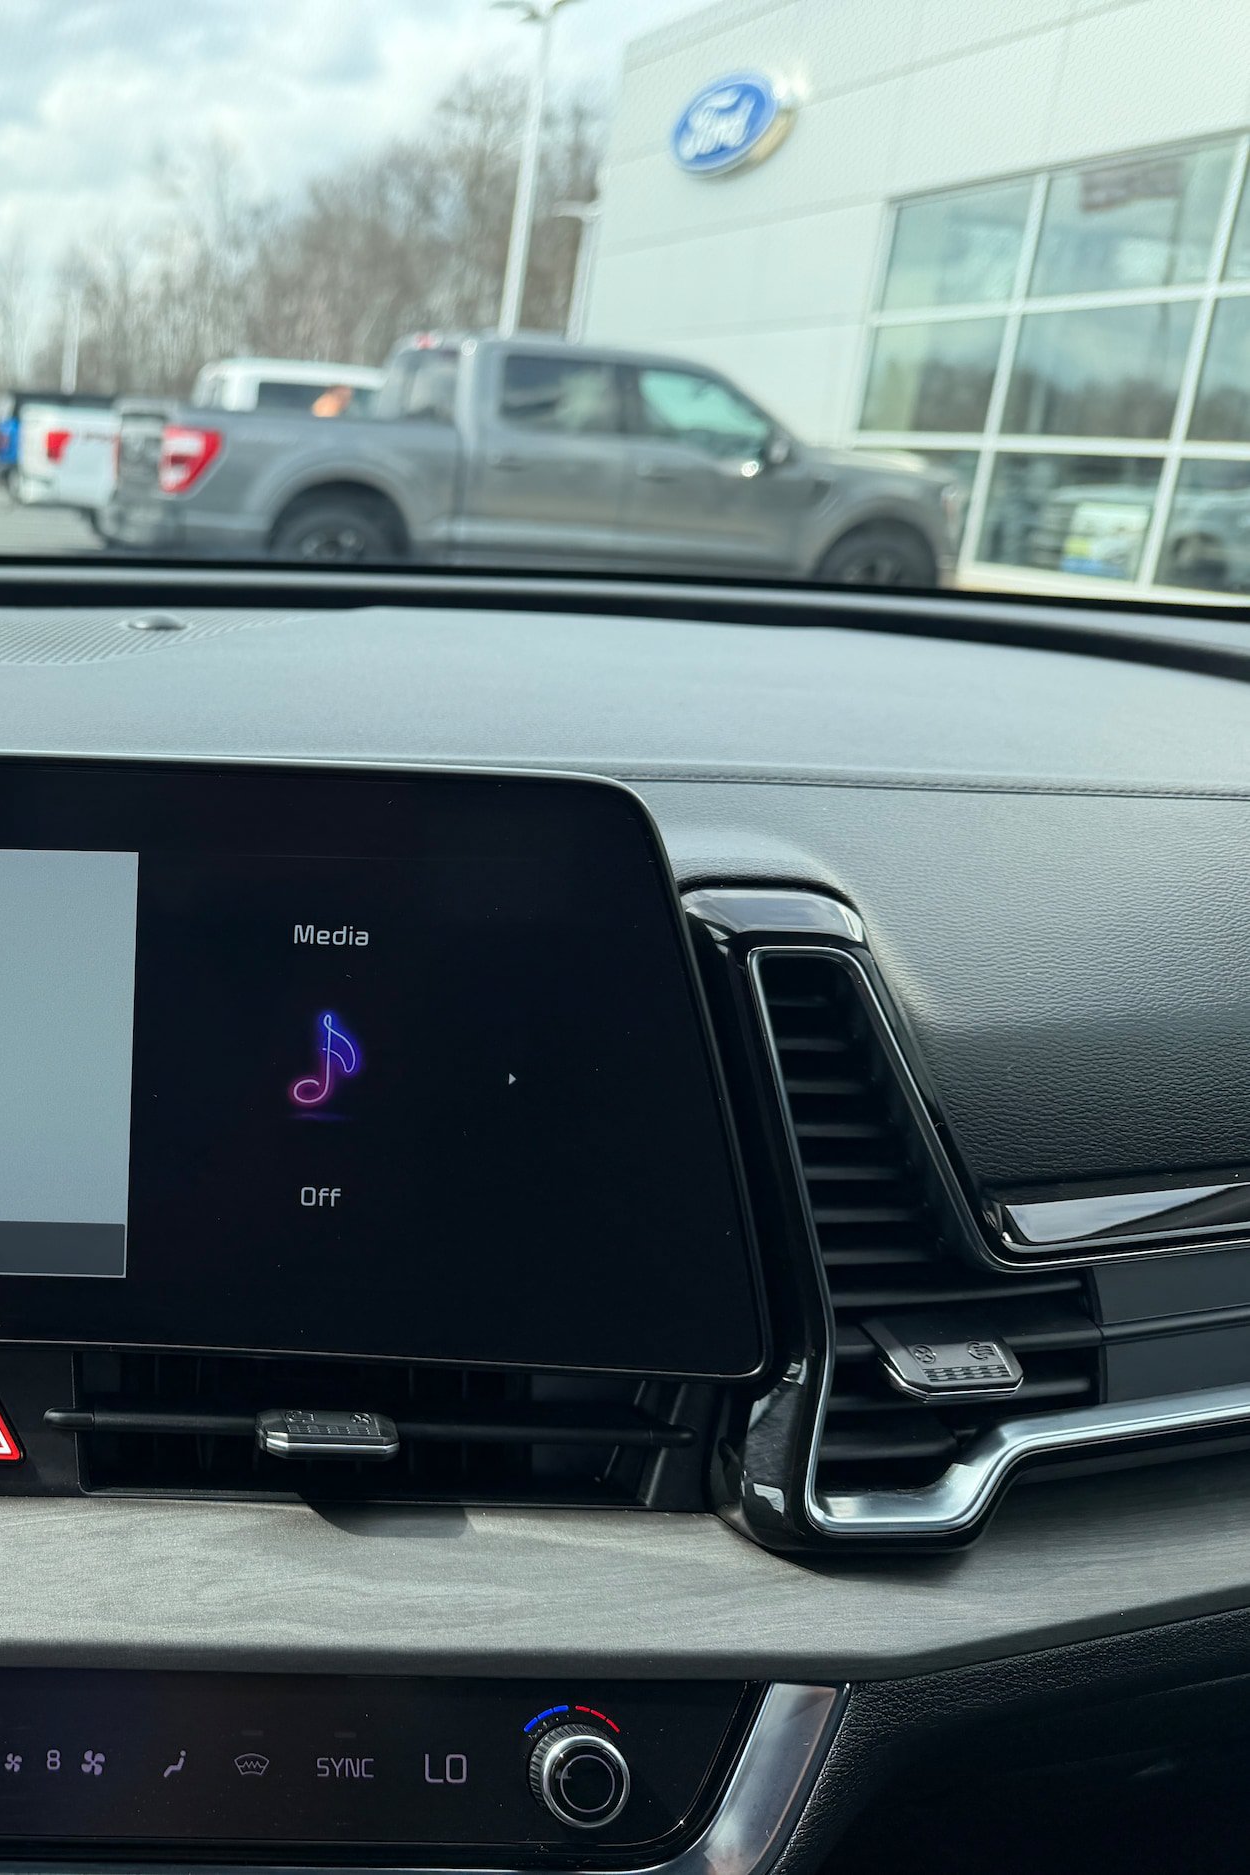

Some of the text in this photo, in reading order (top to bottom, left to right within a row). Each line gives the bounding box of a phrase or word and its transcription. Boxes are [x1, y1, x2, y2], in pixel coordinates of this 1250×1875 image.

[677, 86, 756, 161] Ford
[293, 924, 370, 947] Media
[300, 1186, 342, 1208] Off
[46, 1749, 61, 1770] 8
[316, 1757, 375, 1778] SYNC
[424, 1753, 468, 1784] LO
